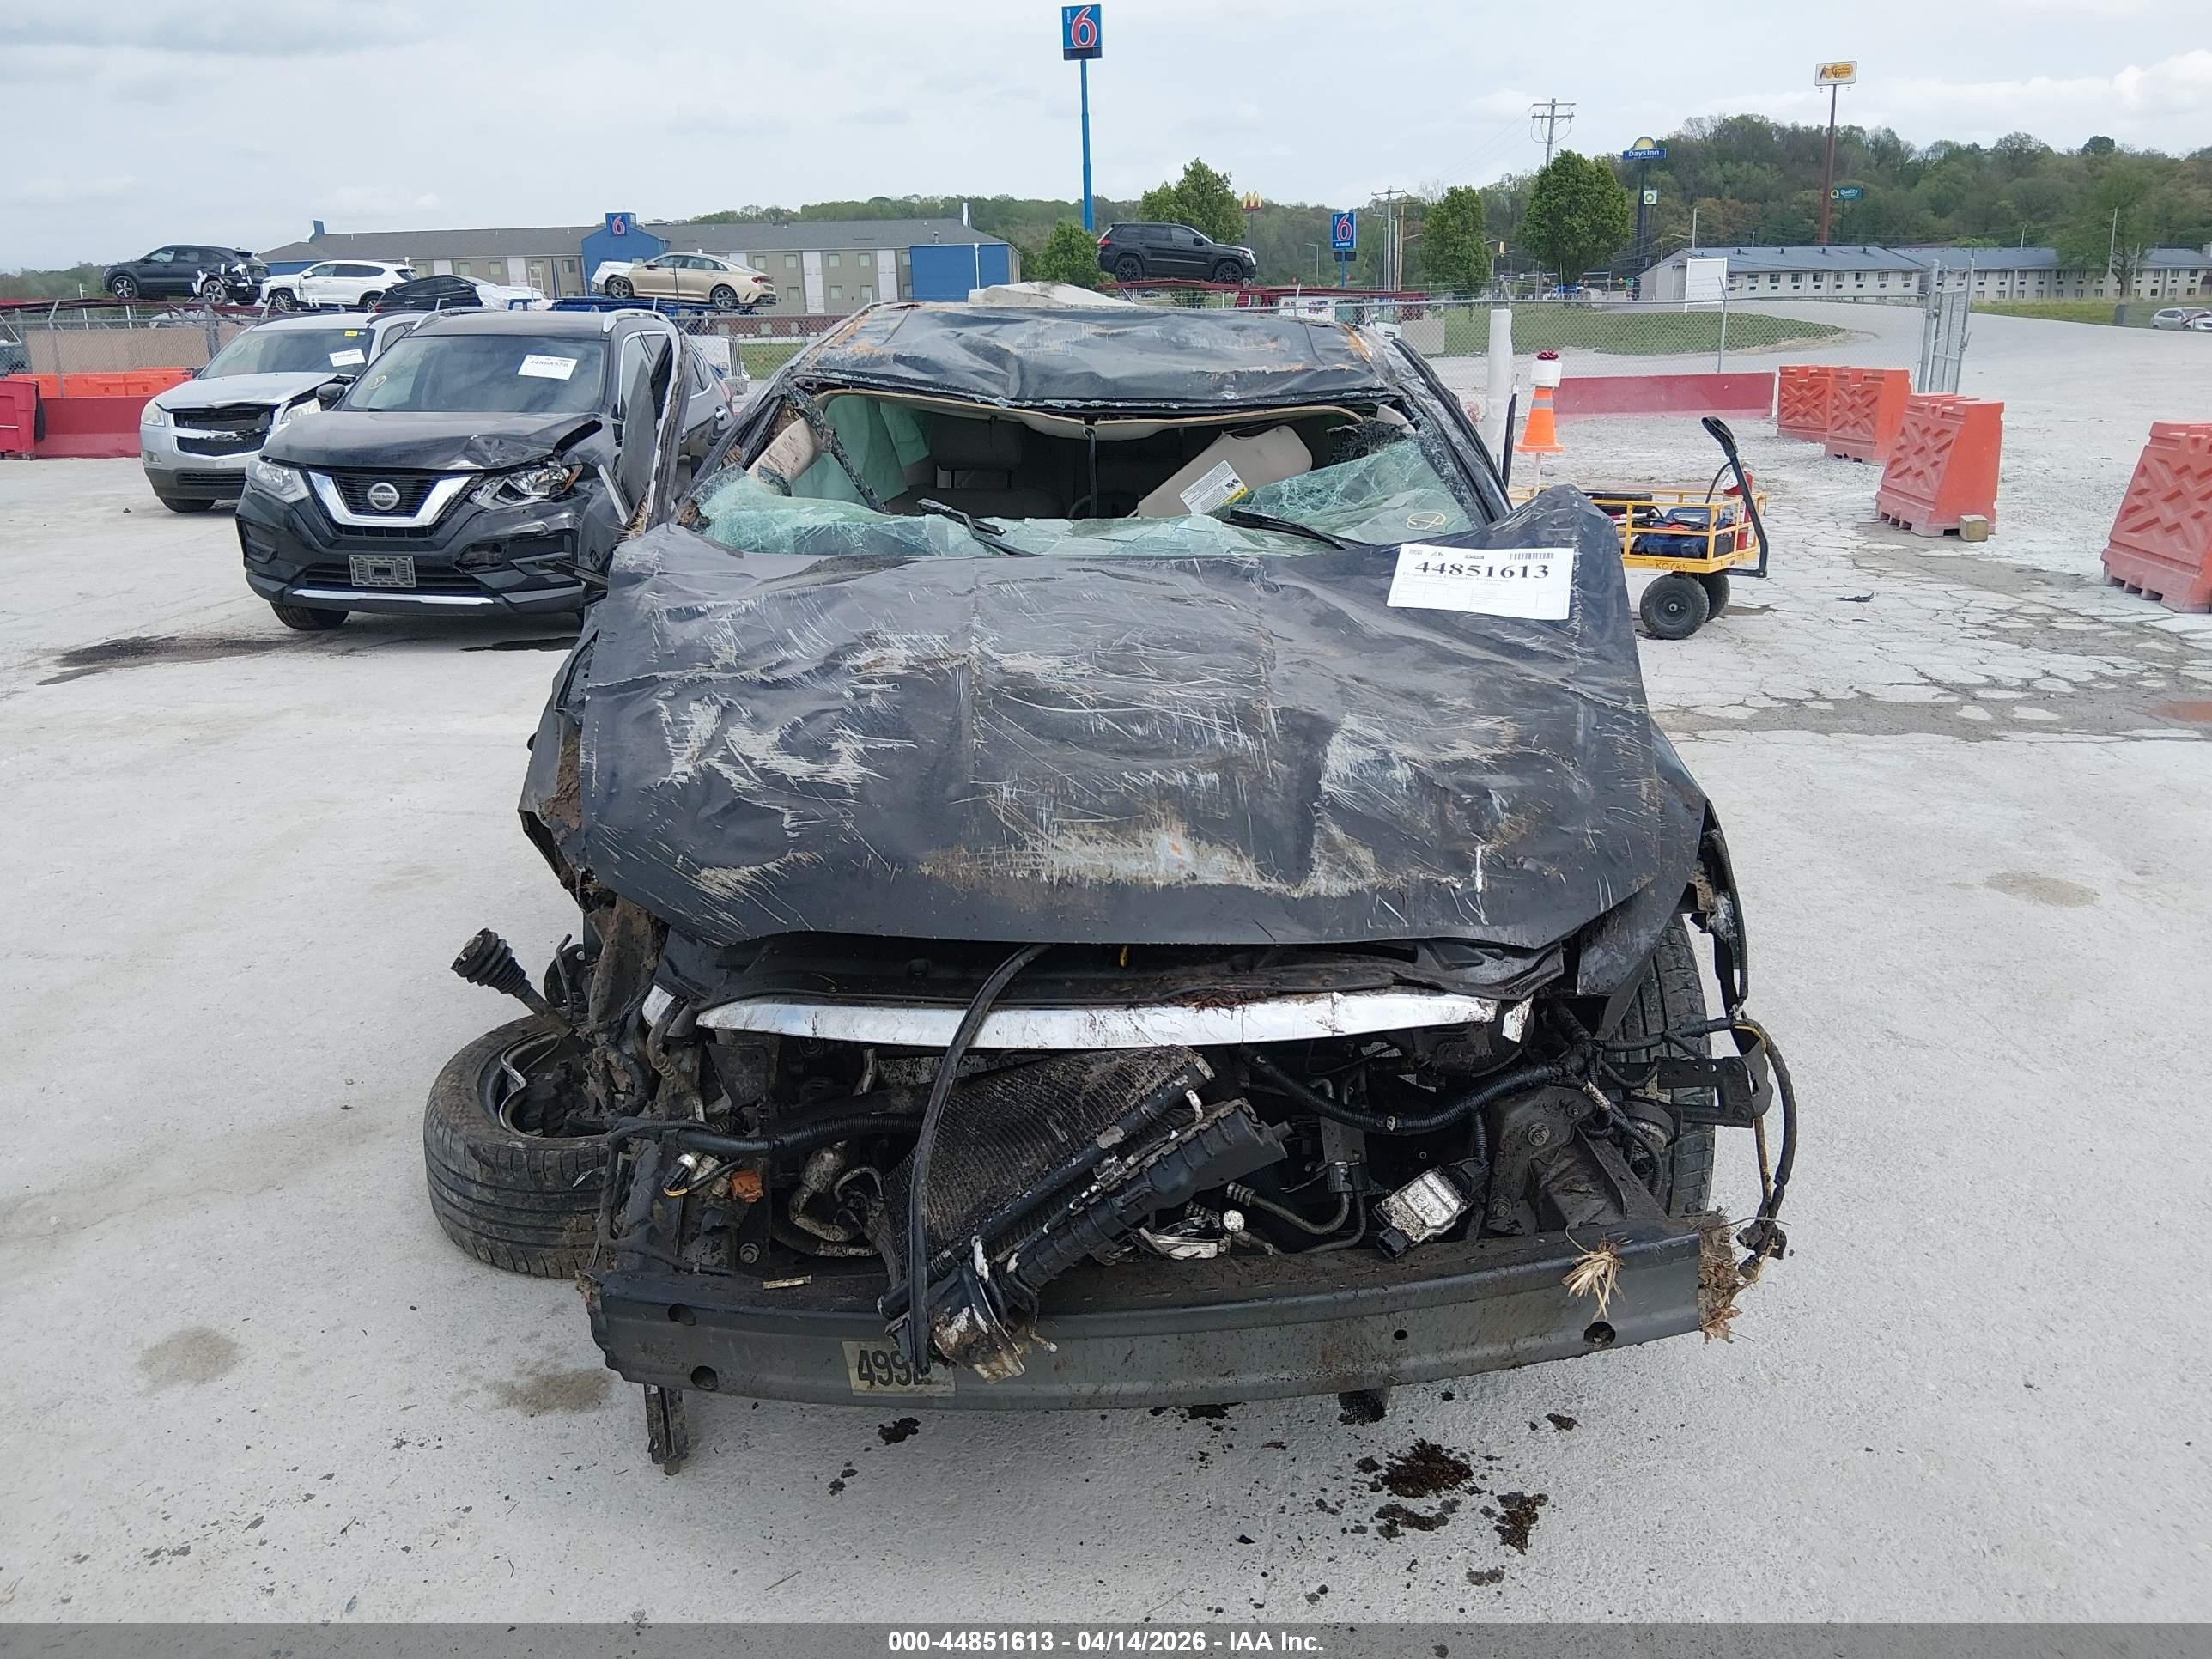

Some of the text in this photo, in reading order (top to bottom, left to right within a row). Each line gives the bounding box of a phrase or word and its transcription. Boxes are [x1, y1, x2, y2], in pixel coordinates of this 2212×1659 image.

[1071, 6, 1097, 47] 6
[612, 216, 626, 235] 6
[1336, 214, 1352, 241] 6
[1414, 561, 1549, 579] 44851613
